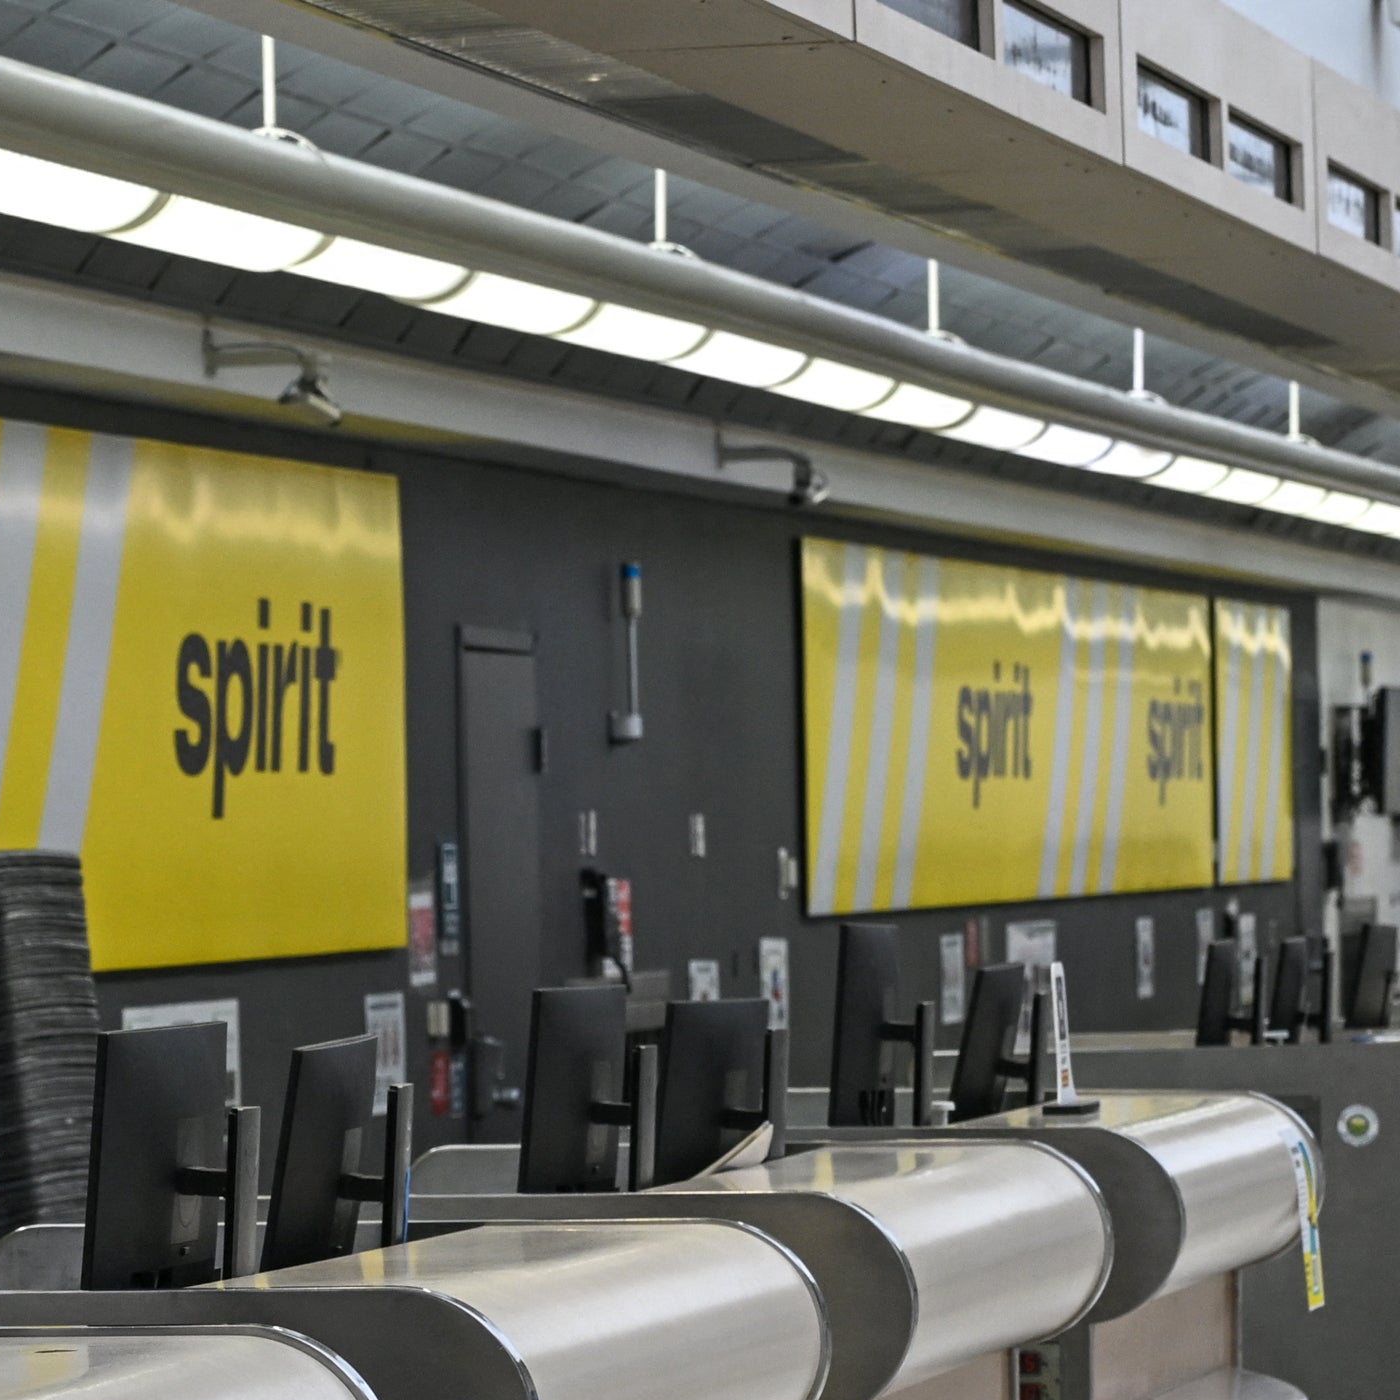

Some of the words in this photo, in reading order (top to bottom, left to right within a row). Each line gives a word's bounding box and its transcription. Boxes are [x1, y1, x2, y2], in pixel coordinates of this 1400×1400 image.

[173, 597, 337, 820] spirit
[955, 660, 1034, 809] spirit
[1147, 676, 1206, 807] spirit
